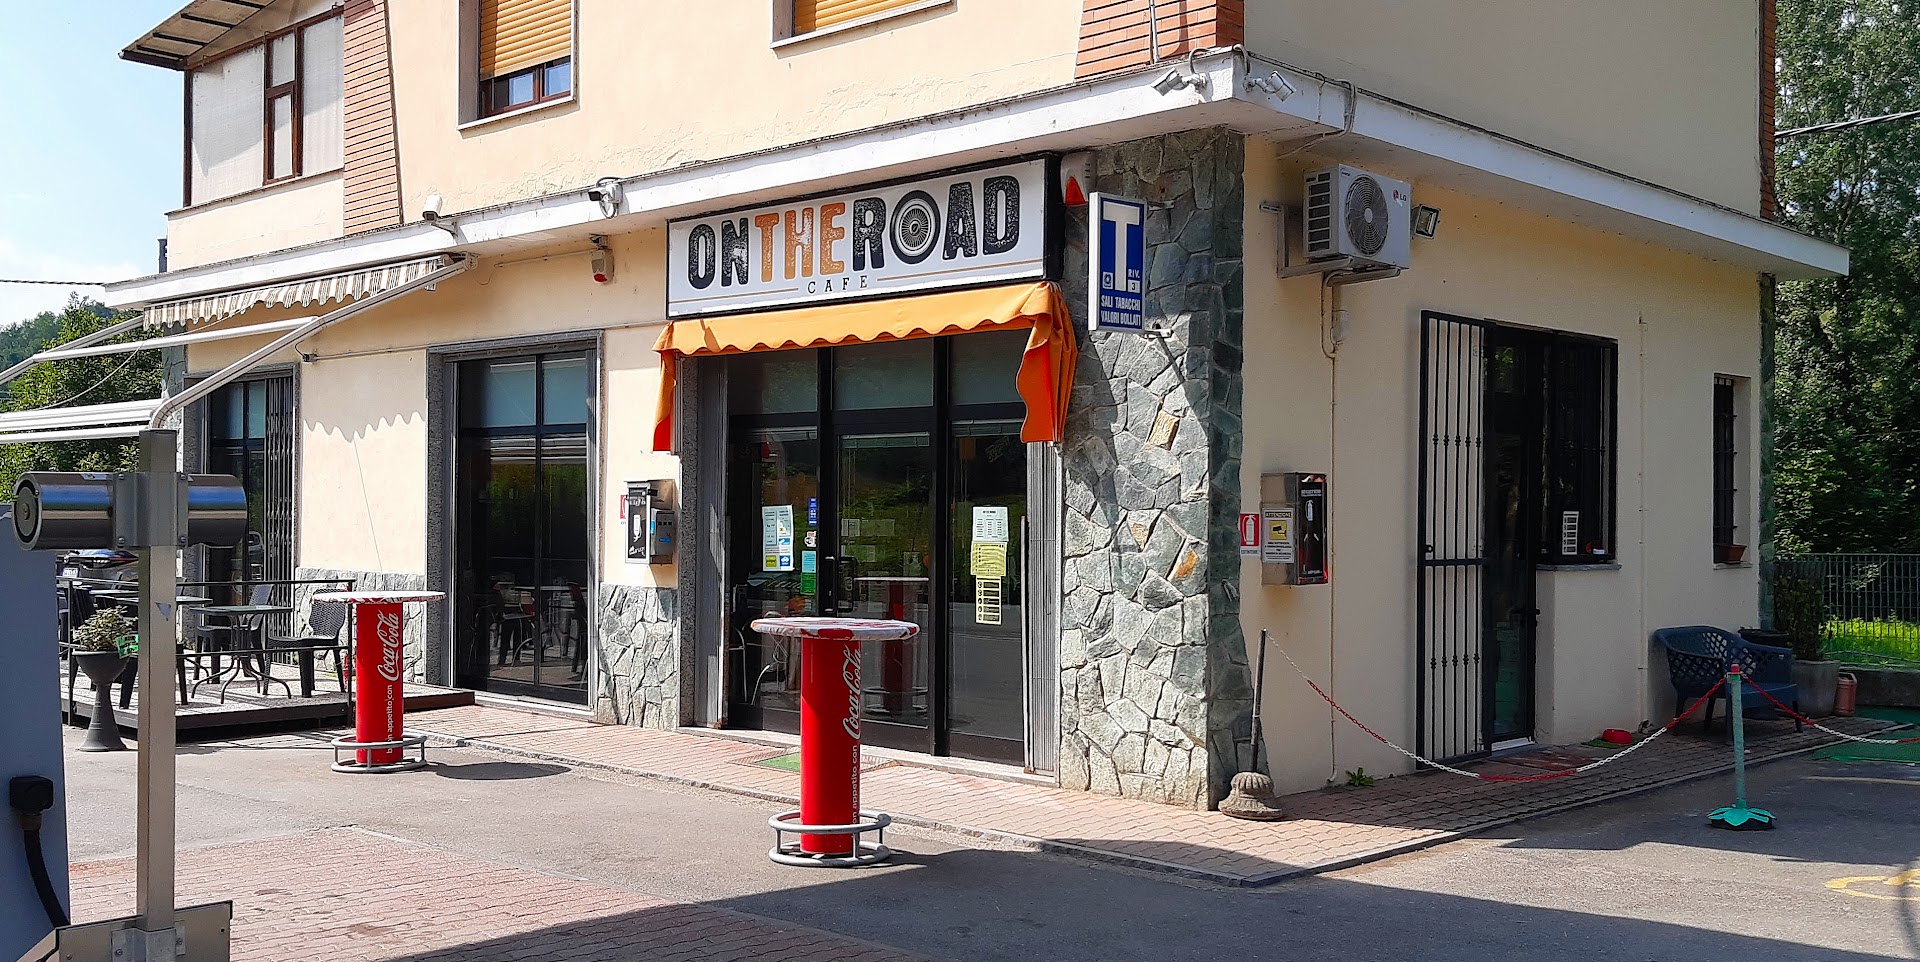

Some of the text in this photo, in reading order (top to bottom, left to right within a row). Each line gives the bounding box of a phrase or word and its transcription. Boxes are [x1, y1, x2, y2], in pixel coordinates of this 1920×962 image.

[1399, 193, 1407, 202] LG
[1102, 200, 1140, 292] T
[807, 275, 868, 294] CAFE
[1131, 282, 1136, 291] 3
[1101, 294, 1141, 311] SALI TABACCHI
[1101, 310, 1141, 326] VALORI BOLLATI
[386, 700, 394, 733] appetito
[851, 766, 859, 808] appetito
